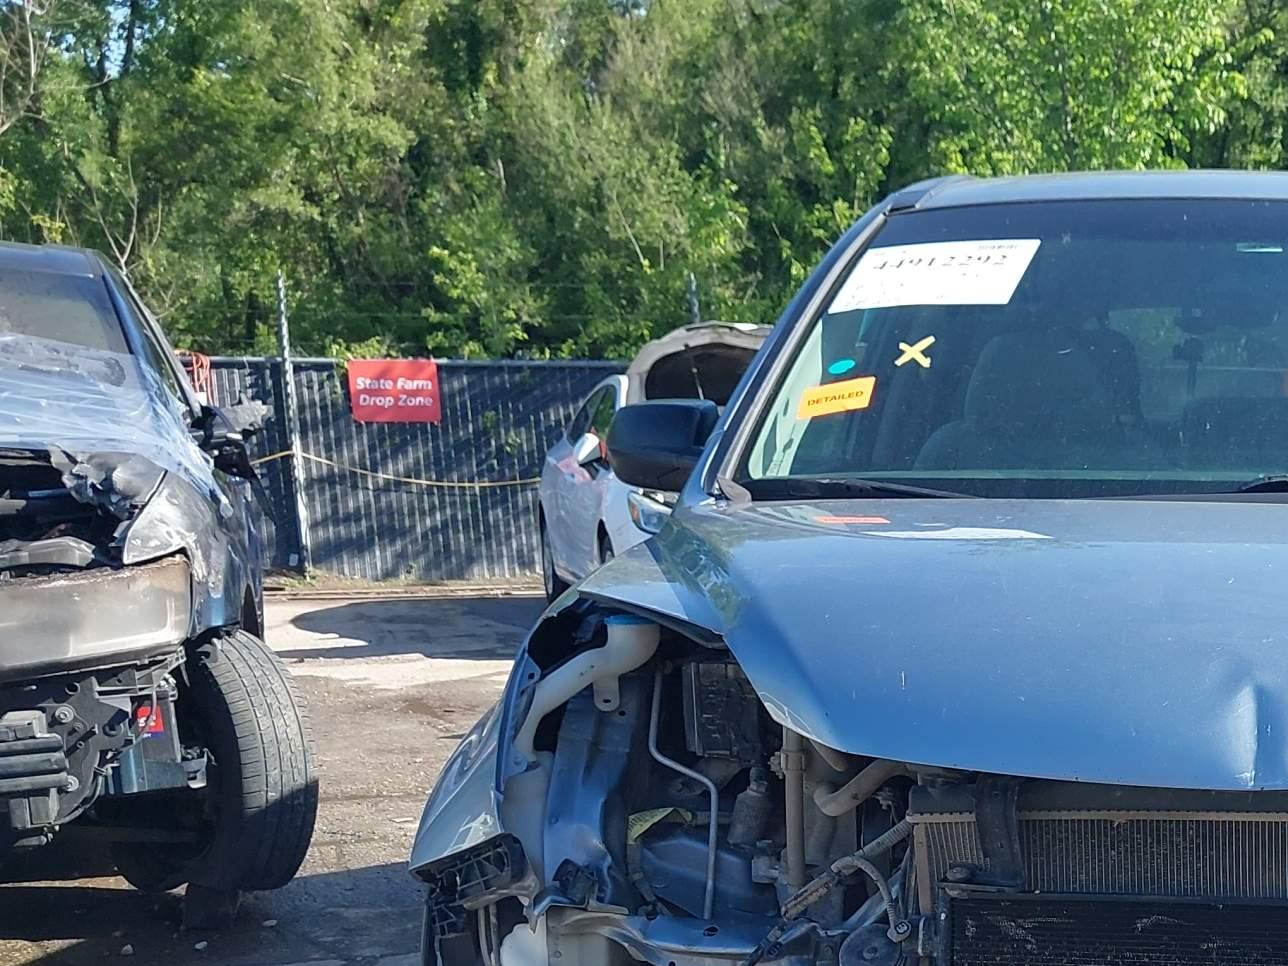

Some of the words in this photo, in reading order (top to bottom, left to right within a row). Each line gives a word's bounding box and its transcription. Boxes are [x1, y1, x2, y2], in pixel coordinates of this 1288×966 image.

[356, 376, 394, 390] State
[397, 377, 432, 390] Farm
[359, 394, 394, 408] Drop
[398, 394, 433, 406] Zone
[806, 390, 864, 406] DETAILED
